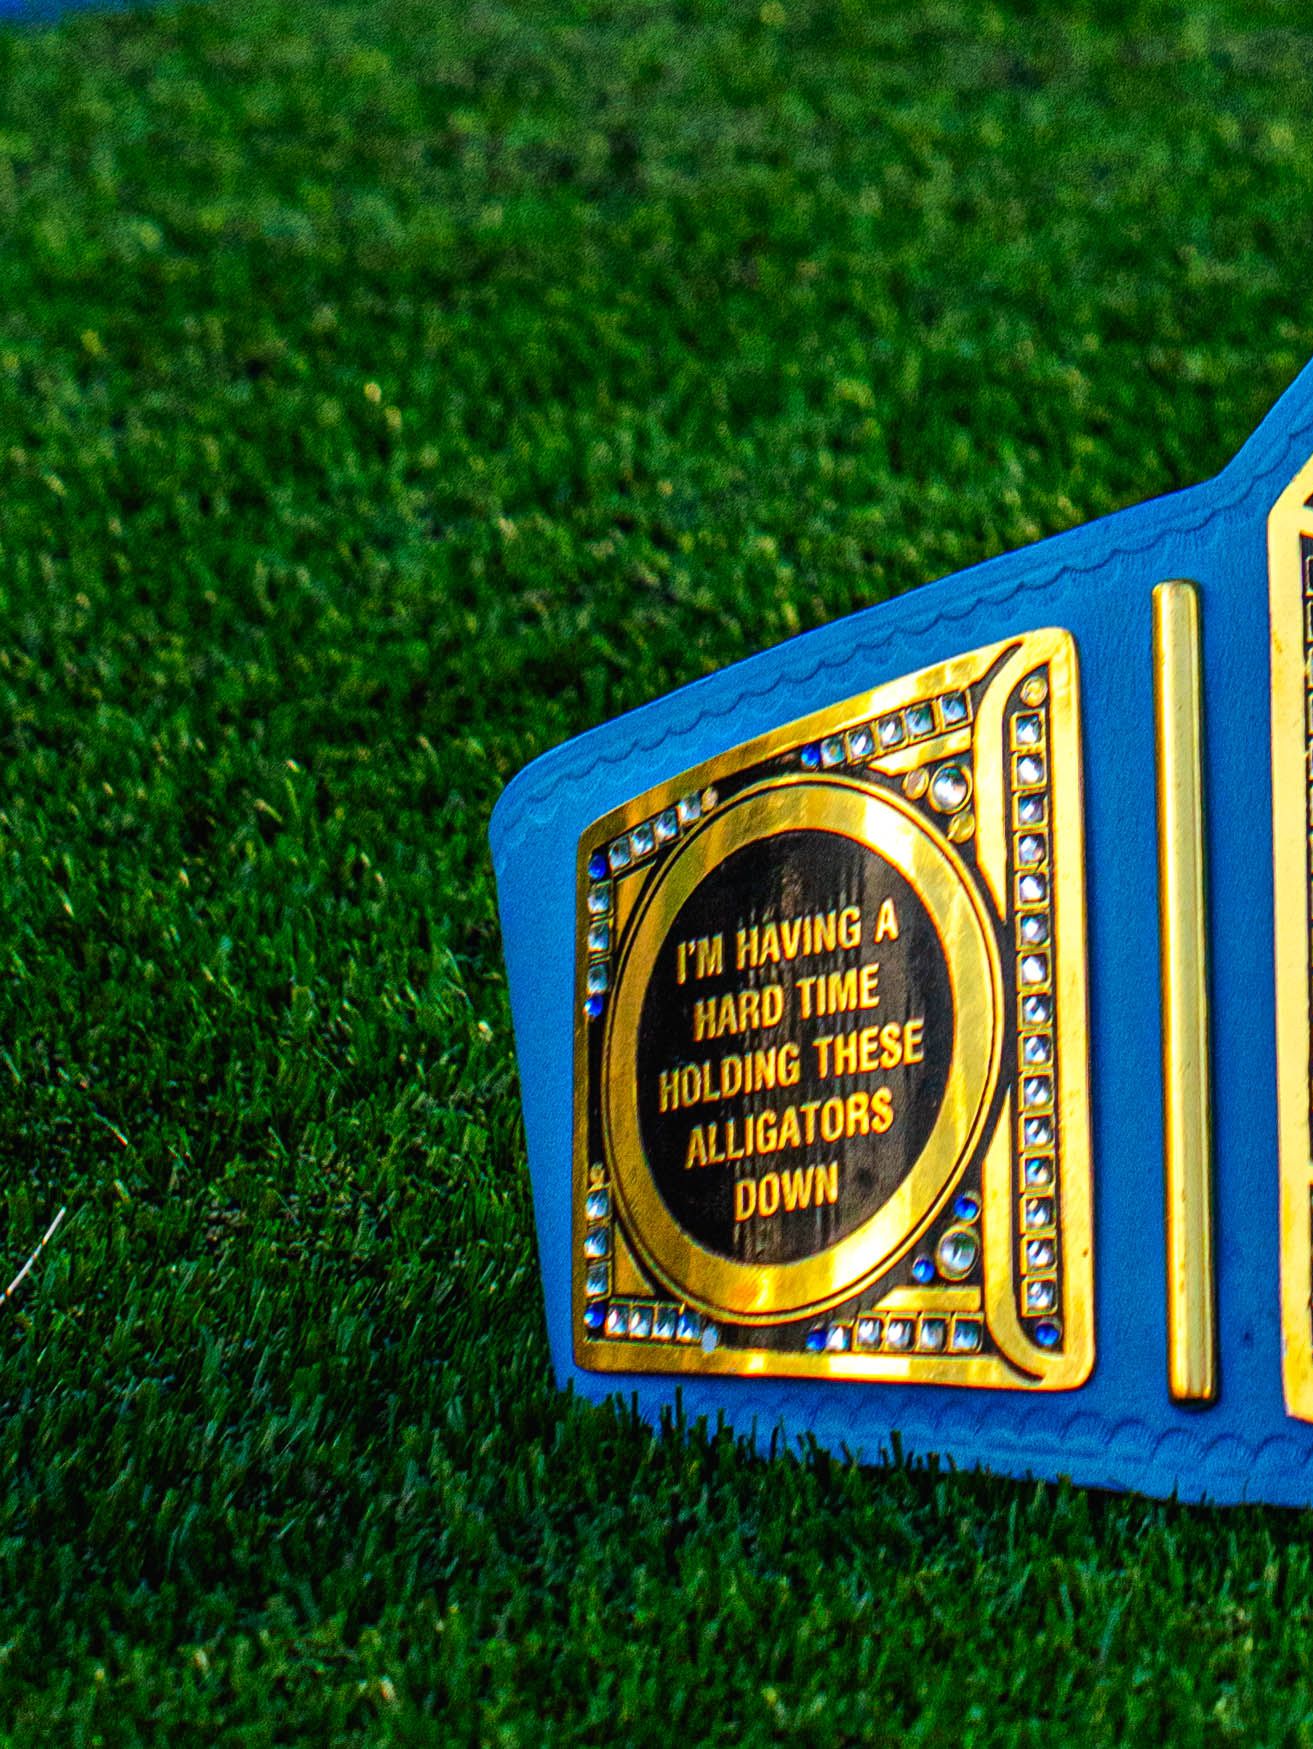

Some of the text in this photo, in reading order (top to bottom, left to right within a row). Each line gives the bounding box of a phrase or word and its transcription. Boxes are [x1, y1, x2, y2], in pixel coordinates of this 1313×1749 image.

[677, 899, 899, 984] I'M HAVING A
[694, 964, 880, 1042] HARD TIME
[658, 1018, 925, 1112] HOLDING THESE
[684, 1086, 895, 1170] ALLIGATORS
[734, 1163, 839, 1223] DOWN
